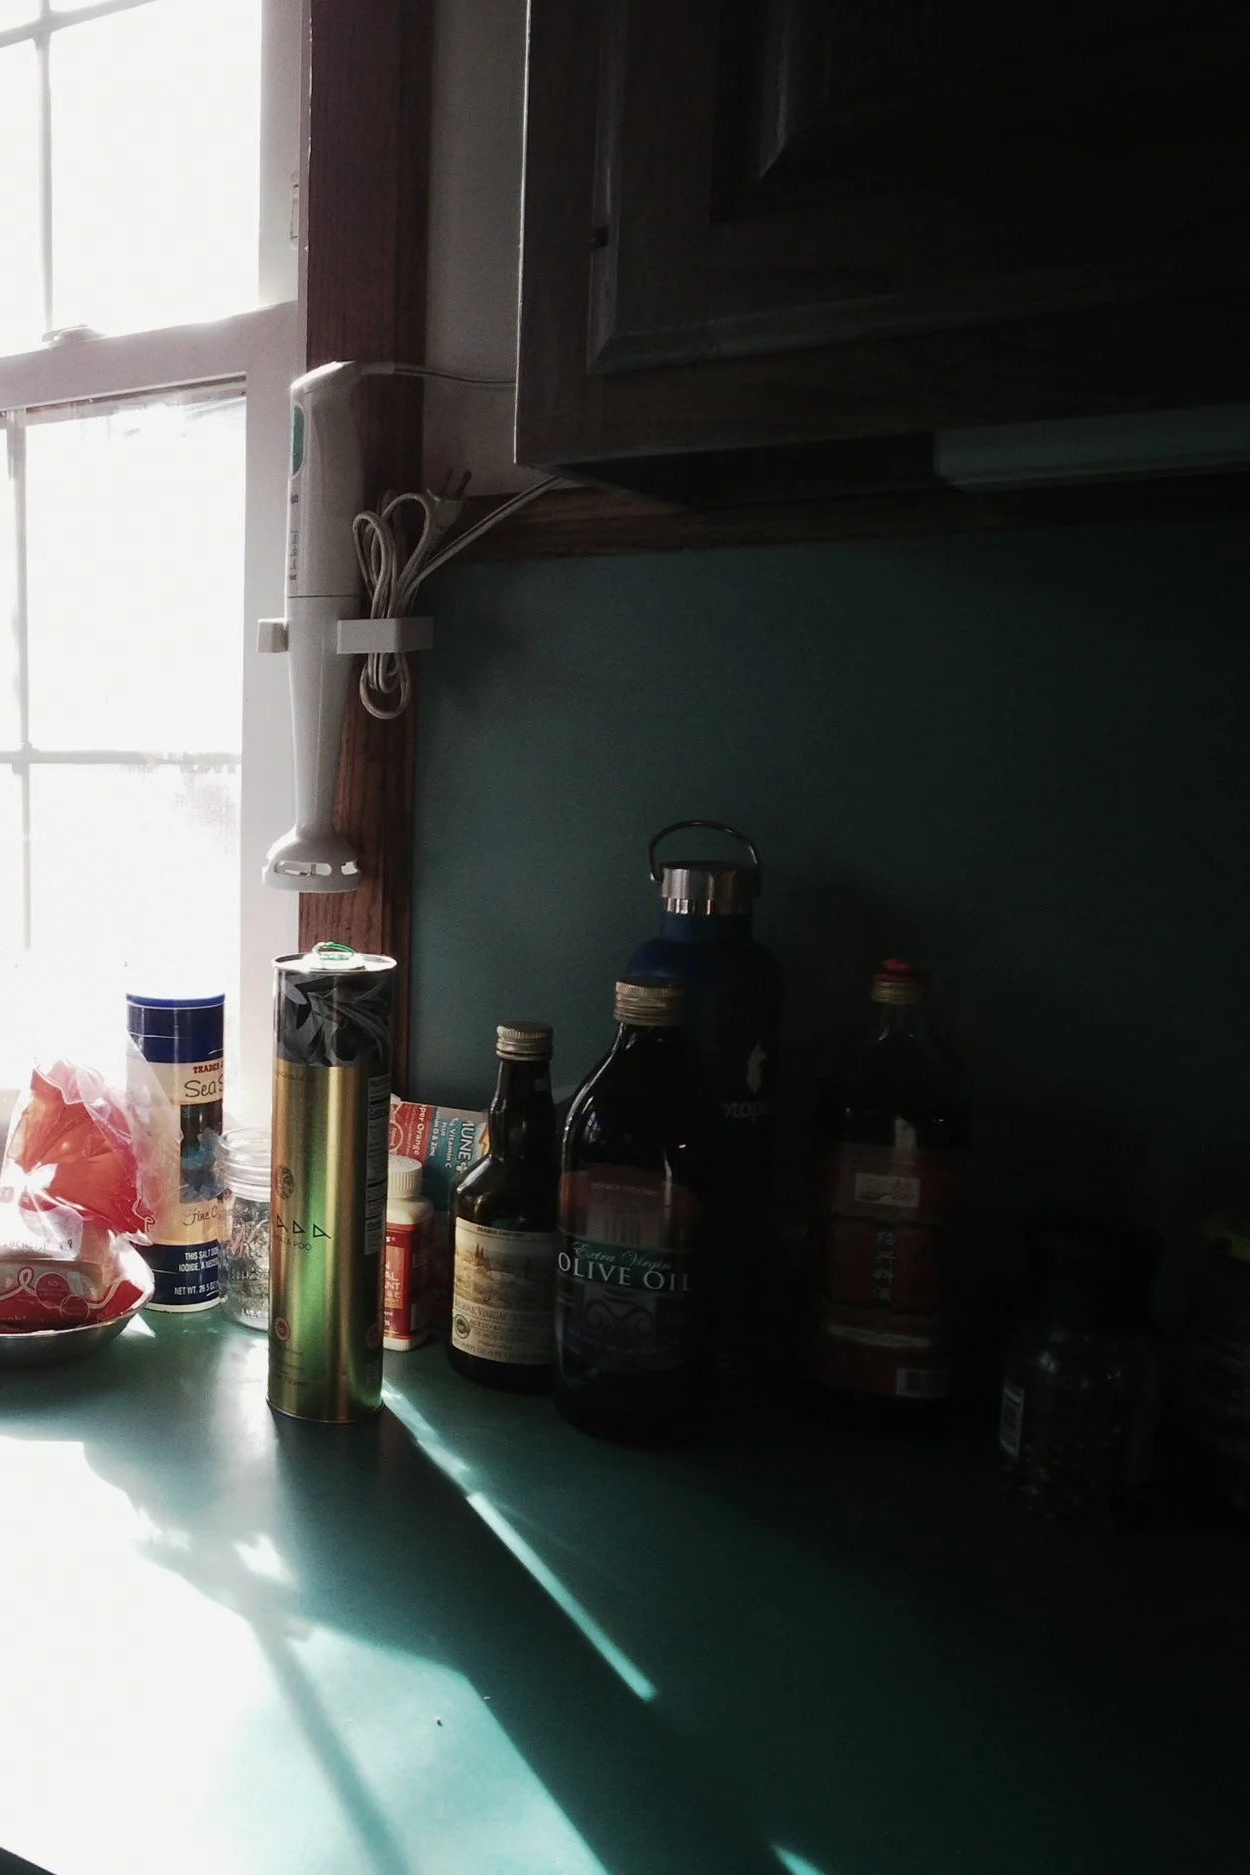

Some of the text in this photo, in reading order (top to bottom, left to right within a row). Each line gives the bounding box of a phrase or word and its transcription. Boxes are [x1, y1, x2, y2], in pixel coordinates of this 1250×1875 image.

[184, 1079, 217, 1098] Sea
[412, 1123, 425, 1156] Orange
[447, 1128, 456, 1161] Vitamin
[557, 1251, 694, 1292] OLIVE OIL
[573, 1241, 672, 1271] Extra Virgin
